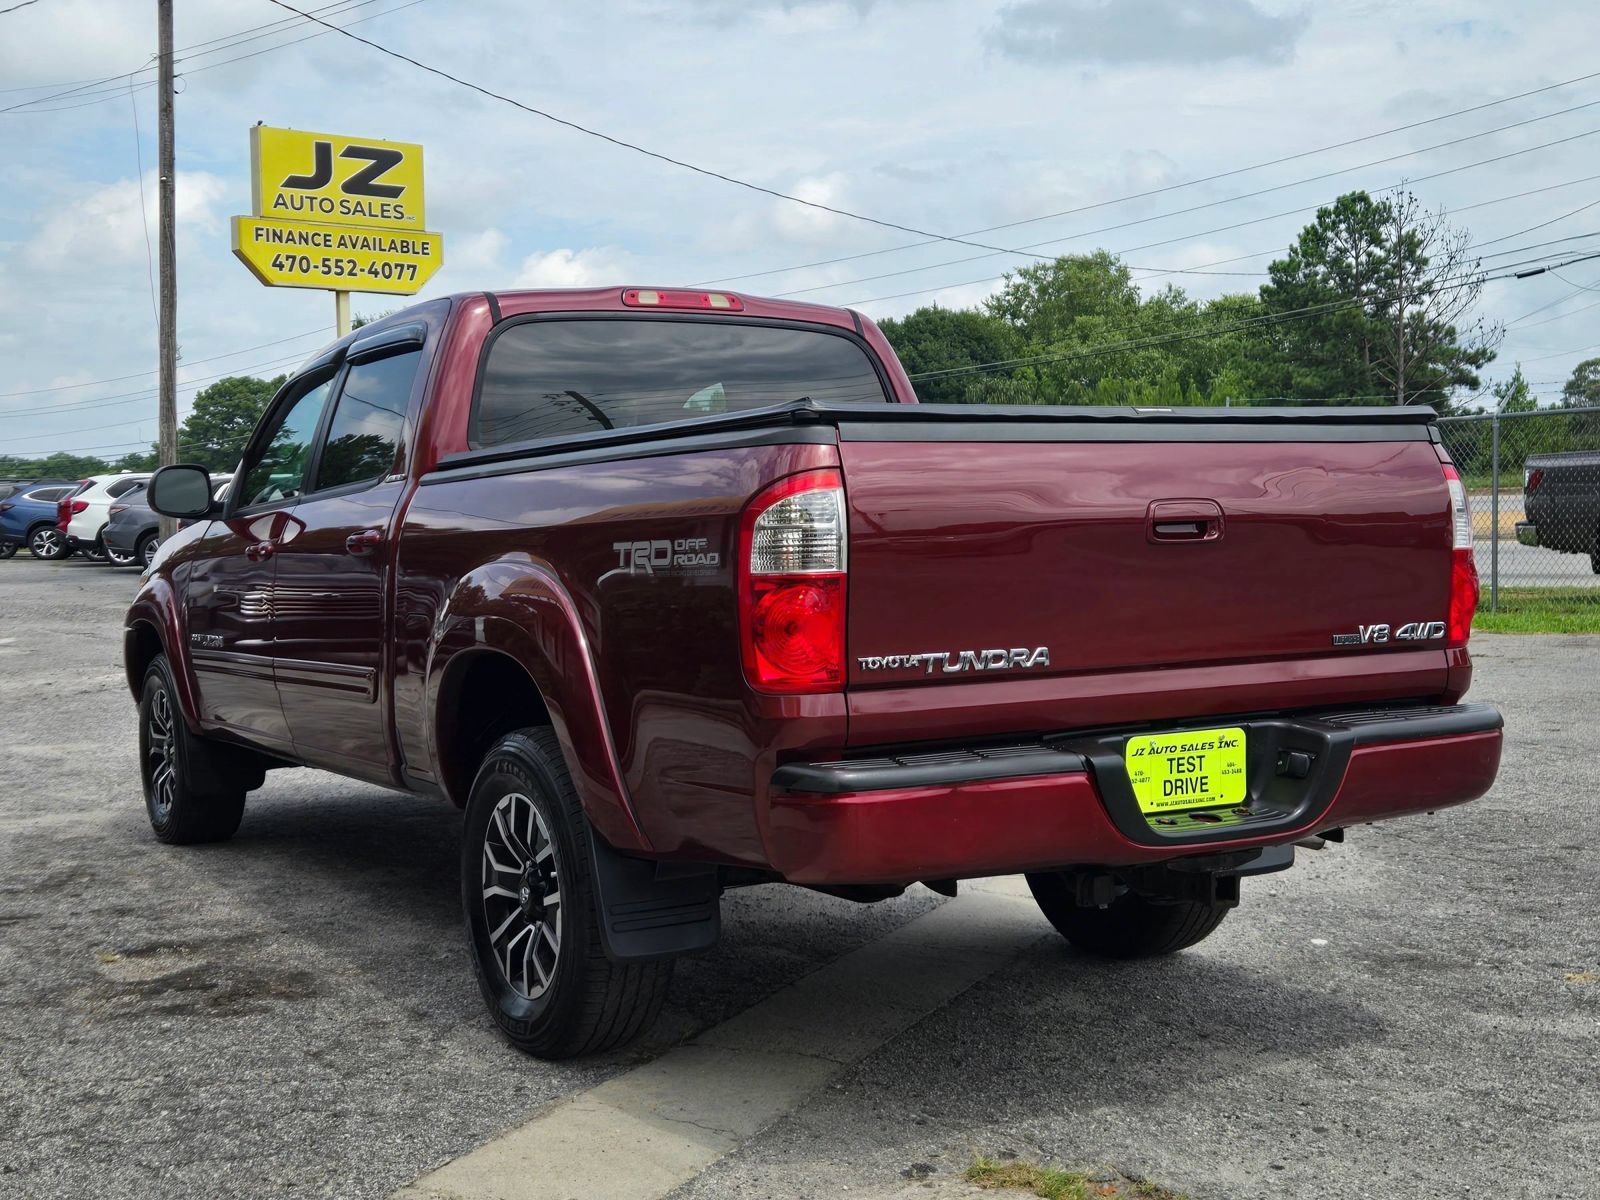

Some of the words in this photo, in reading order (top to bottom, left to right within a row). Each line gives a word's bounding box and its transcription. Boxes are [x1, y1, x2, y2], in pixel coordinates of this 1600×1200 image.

[280, 141, 406, 199] JZ
[273, 193, 335, 214] AUTO
[339, 199, 405, 220] SALES
[254, 227, 333, 248] FINANCE
[337, 234, 430, 256] AVAILABLE
[271, 253, 418, 281] 470-552-4077
[612, 540, 672, 574] TRD
[674, 538, 708, 551] OFF
[673, 552, 720, 566] ROAD
[1358, 623, 1390, 644] V8
[1394, 621, 1447, 641] 4WD
[857, 654, 922, 670] TOYOTA
[920, 647, 1050, 674] TUNDRA
[1131, 748, 1146, 757] JZ
[1148, 745, 1178, 755] AUTO
[1180, 741, 1215, 752] SALES
[1166, 754, 1206, 775] TEST
[1163, 775, 1209, 797] DRIVE
